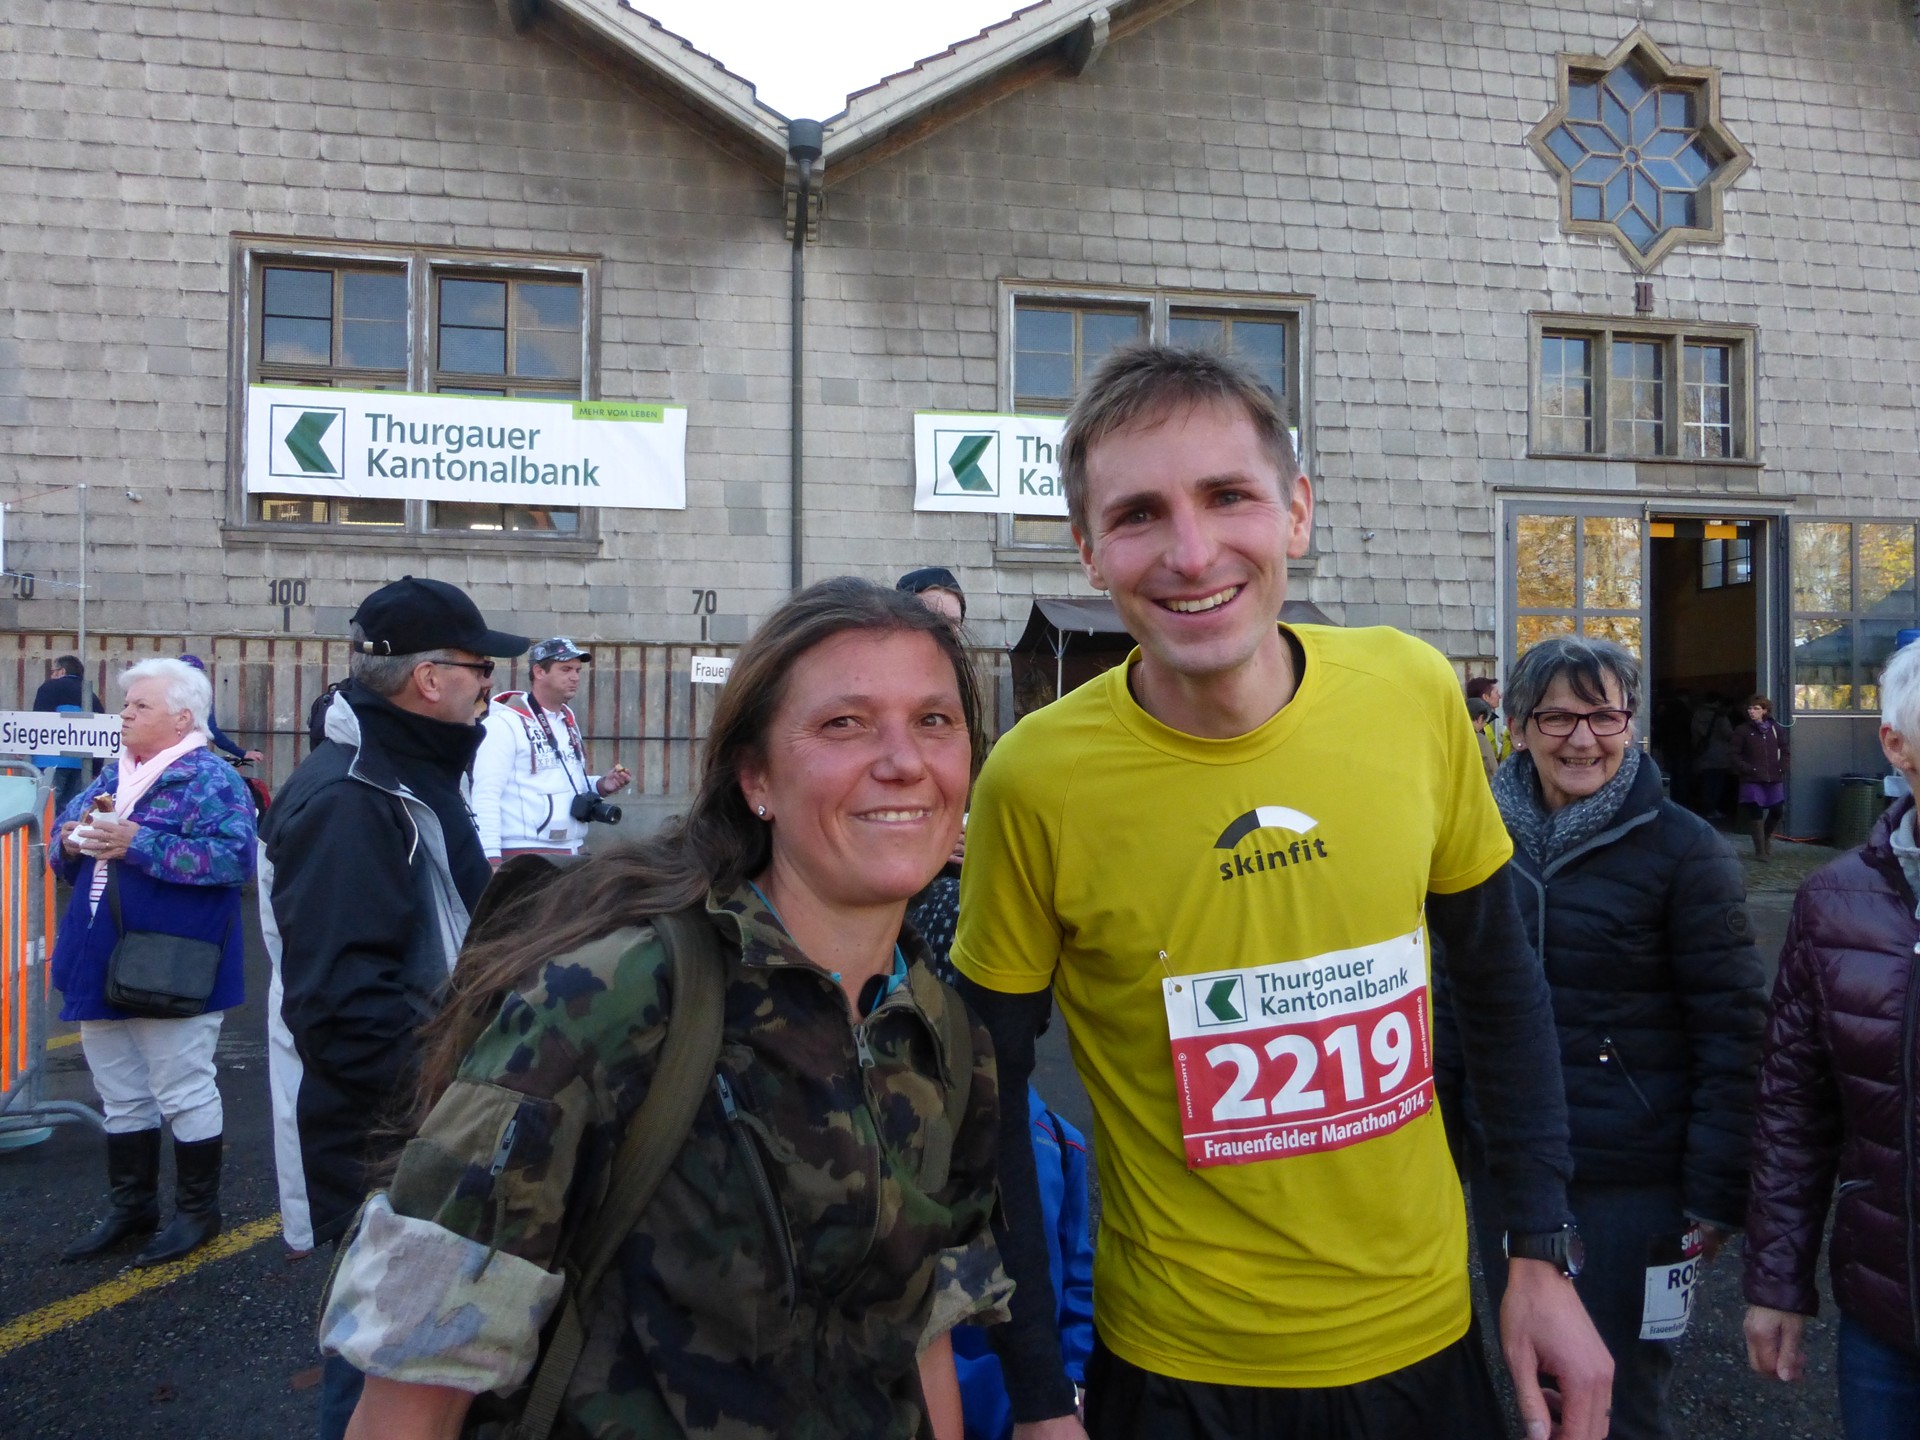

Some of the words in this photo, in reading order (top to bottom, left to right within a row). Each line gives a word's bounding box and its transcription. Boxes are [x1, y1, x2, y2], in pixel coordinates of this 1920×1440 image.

[579, 407, 605, 416] MEHR
[607, 409, 628, 417] VOM
[631, 410, 658, 418] LEBEN
[365, 412, 541, 454] Thurgauer
[367, 447, 600, 487] Kantonalbank
[269, 579, 306, 606] 100
[692, 589, 717, 615] 70
[2, 721, 120, 753] Siegerehrung
[1219, 838, 1328, 881] skinfit
[1255, 957, 1375, 994] Thurgauer
[1260, 967, 1409, 1016] Kantonalbank
[1204, 1011, 1413, 1122] 2219
[1204, 1128, 1317, 1159] Frauenfelder
[1321, 1109, 1397, 1144] Marathon
[1398, 1090, 1425, 1122] 2014
